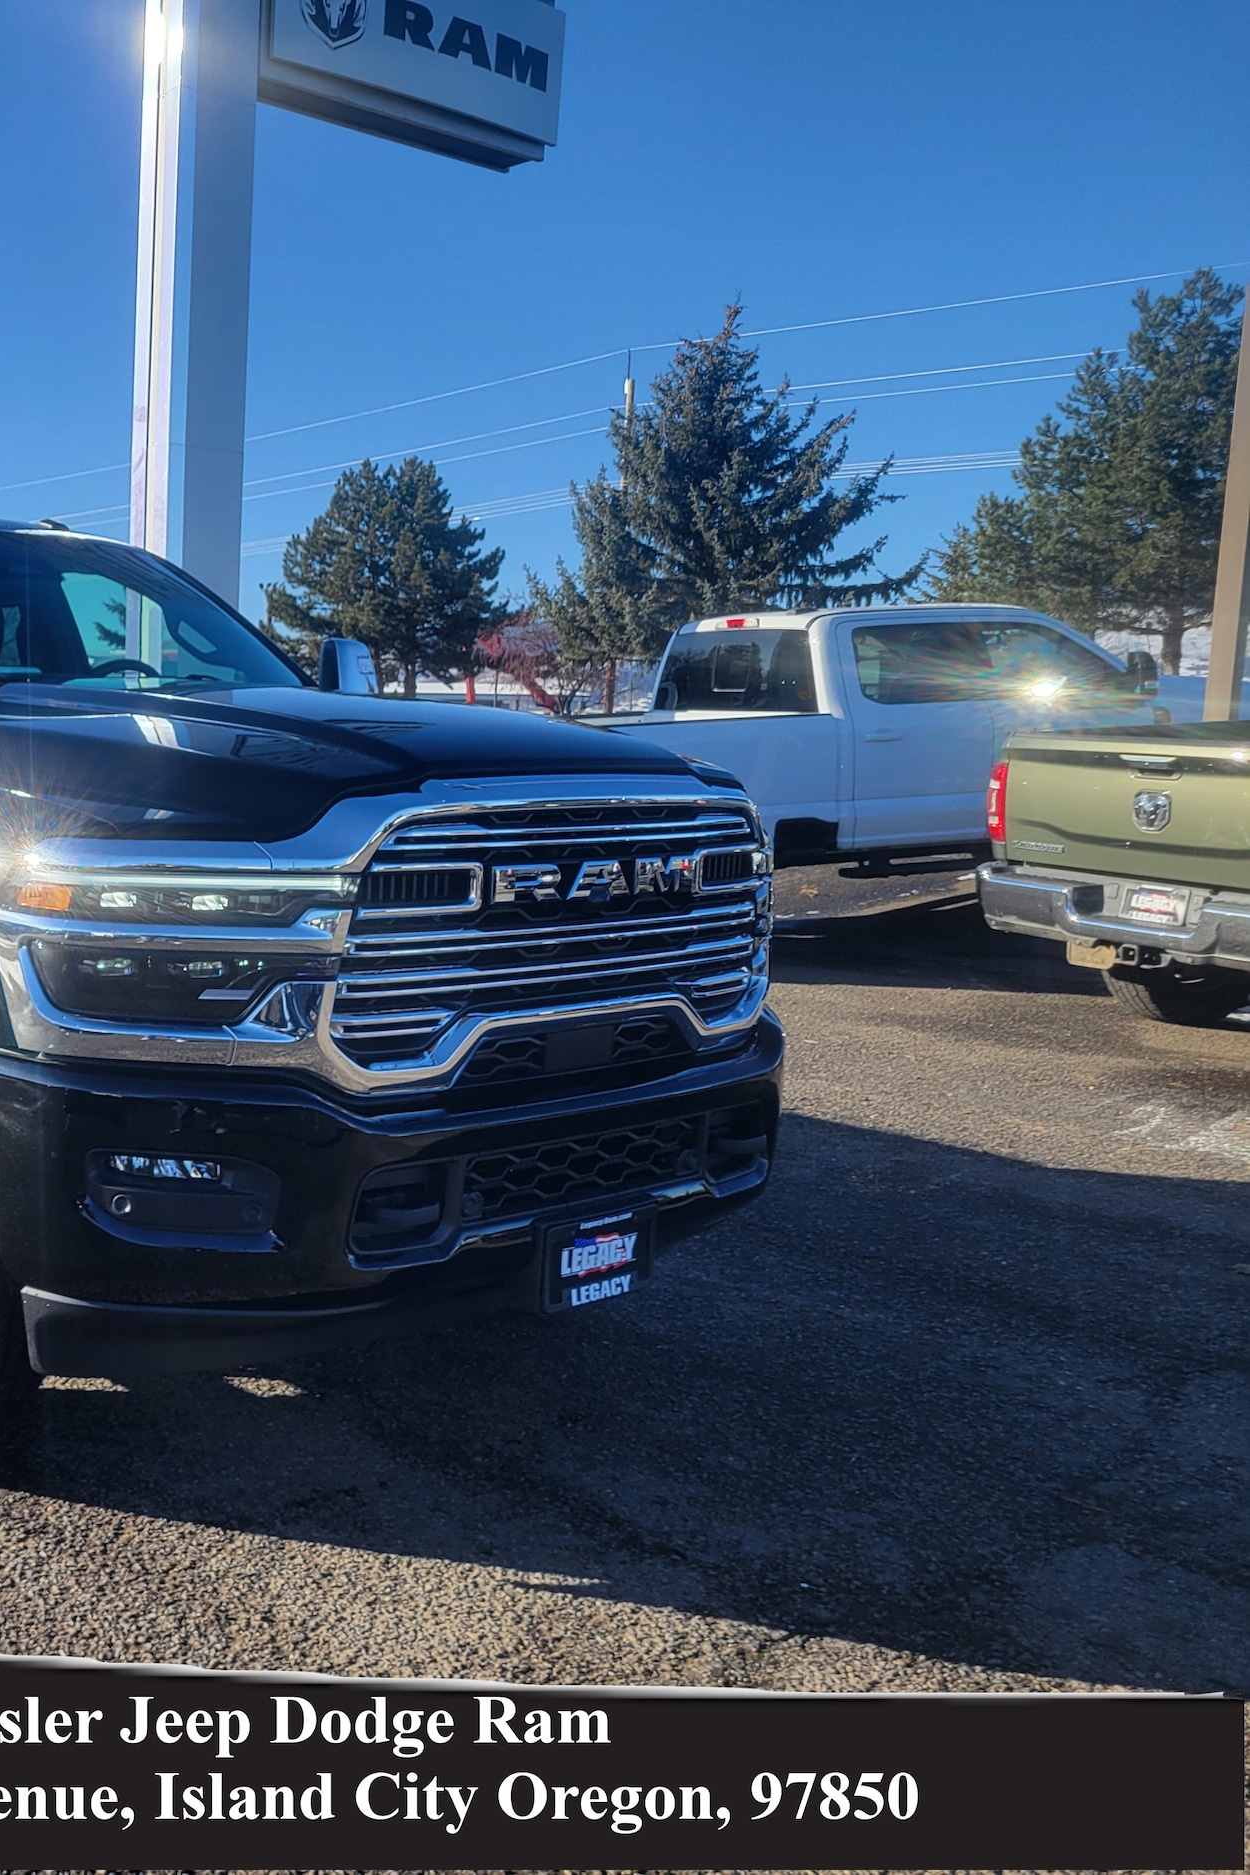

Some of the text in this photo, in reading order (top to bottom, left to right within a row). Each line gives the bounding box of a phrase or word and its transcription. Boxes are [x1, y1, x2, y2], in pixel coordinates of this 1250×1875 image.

[383, 0, 549, 93] RAM
[491, 855, 695, 904] RAM
[560, 1233, 637, 1277] LEGACY
[571, 1274, 631, 1307] LEGACY
